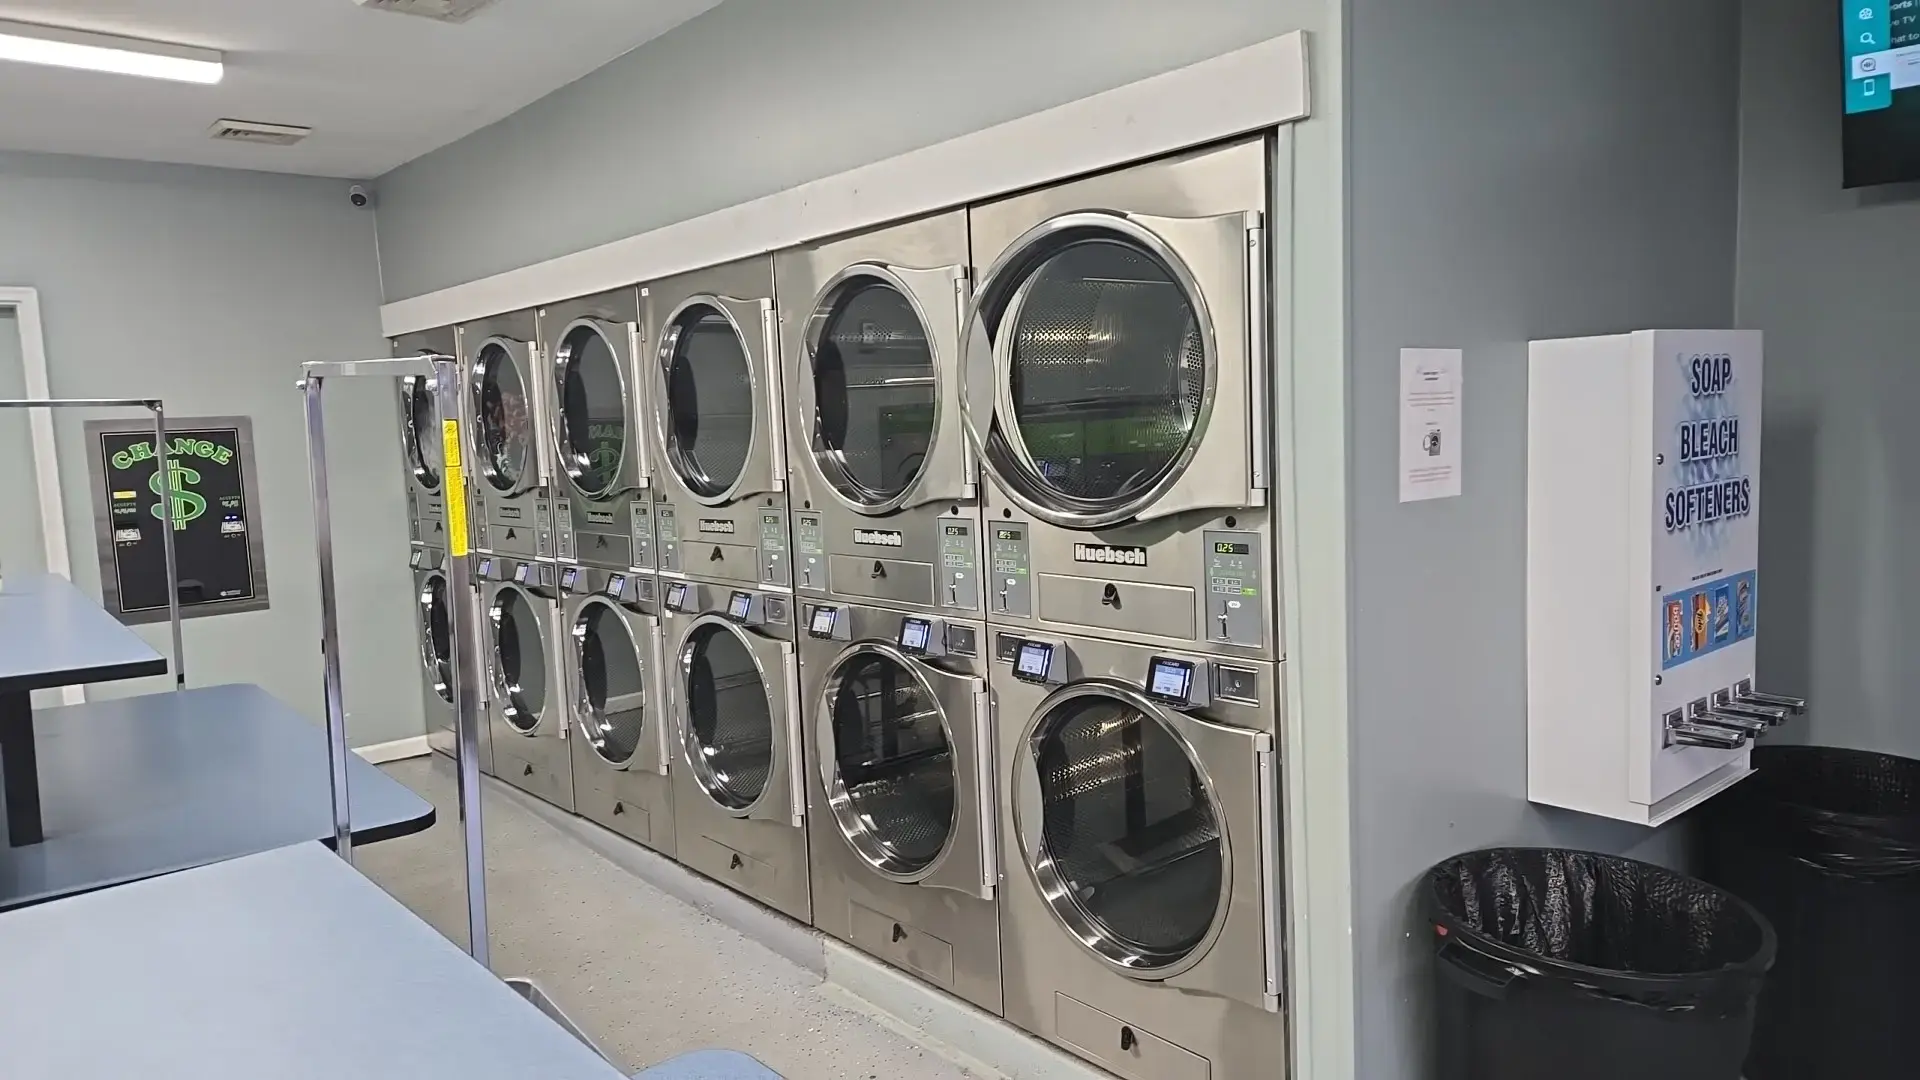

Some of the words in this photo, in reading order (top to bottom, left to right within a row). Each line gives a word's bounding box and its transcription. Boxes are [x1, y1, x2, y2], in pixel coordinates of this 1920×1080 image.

[1902, 15, 1916, 24] TV
[1691, 355, 1732, 395] SOAP
[1680, 419, 1740, 461] BLEACH
[1665, 478, 1750, 530] SOFTENERS
[1075, 544, 1146, 565] Huebsch
[1216, 543, 1234, 553] 0.25
